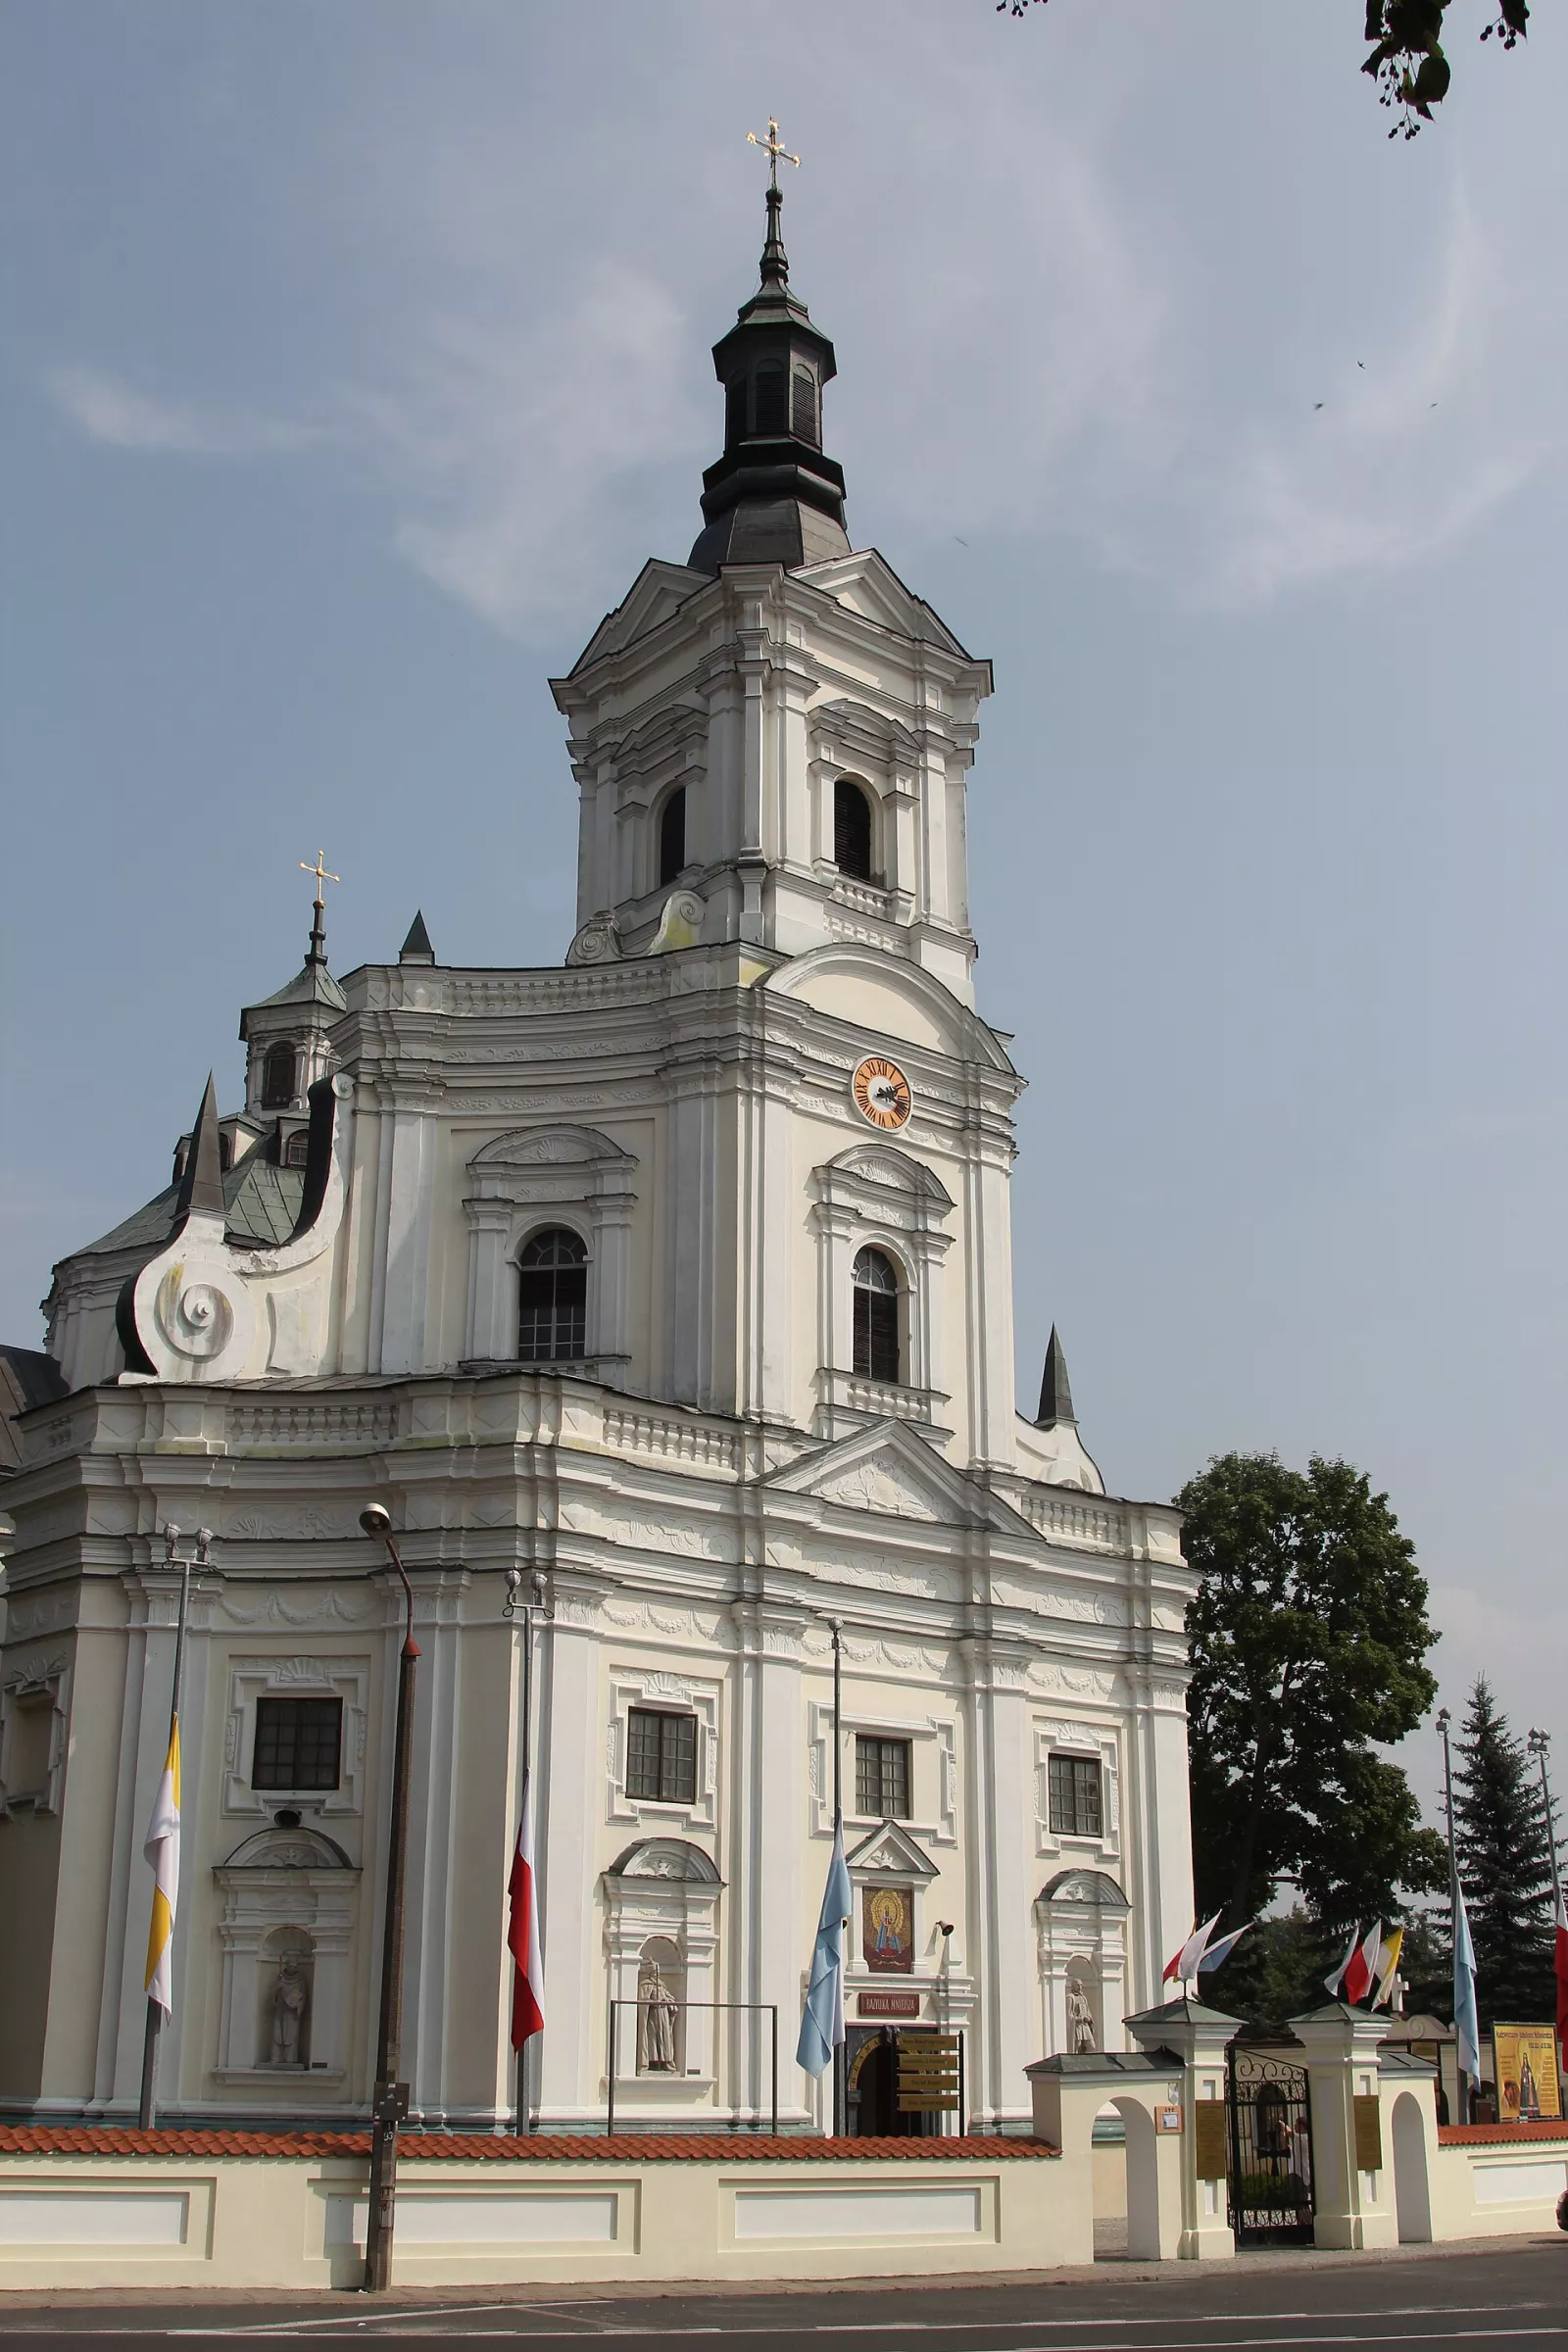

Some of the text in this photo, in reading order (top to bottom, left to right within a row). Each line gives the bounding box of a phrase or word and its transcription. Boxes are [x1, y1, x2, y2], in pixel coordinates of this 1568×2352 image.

[865, 1060, 877, 1077] XI
[876, 1060, 888, 1076] XII
[889, 1068, 897, 1080] I
[858, 1070, 870, 1084] X
[856, 1082, 867, 1094] IX
[890, 1113, 898, 1127] V
